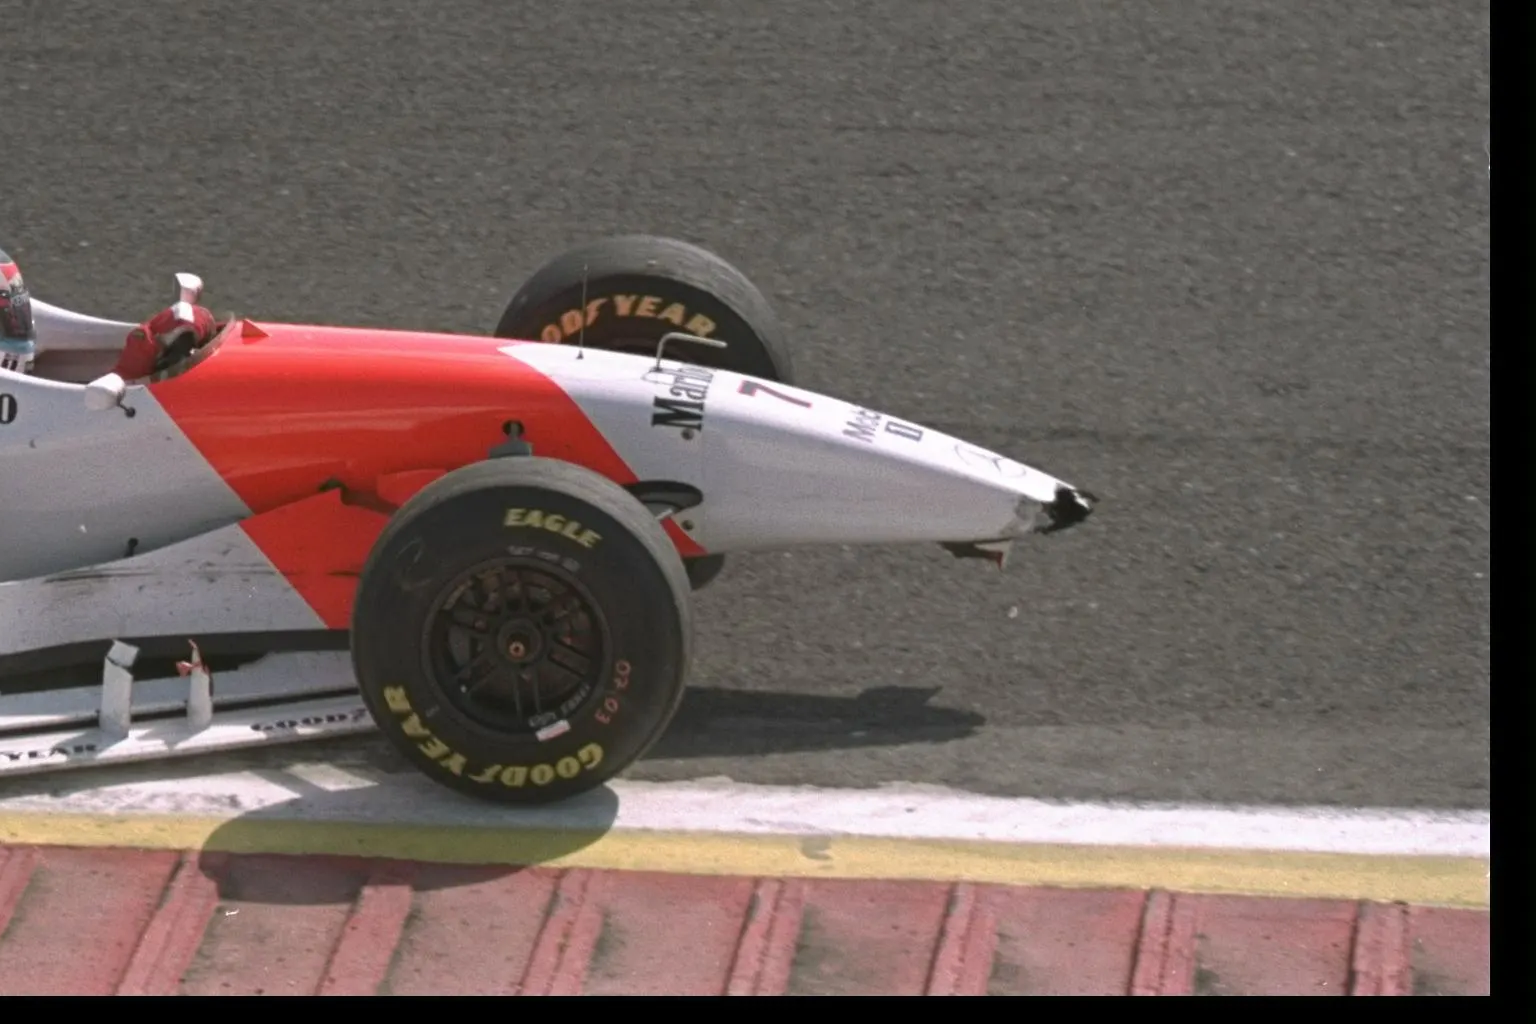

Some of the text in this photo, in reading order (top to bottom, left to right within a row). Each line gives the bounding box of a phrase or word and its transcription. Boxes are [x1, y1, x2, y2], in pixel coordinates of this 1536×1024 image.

[541, 295, 717, 342] ODYEAR
[503, 508, 604, 549] EAGLE
[383, 684, 604, 788] GOODYEAR
